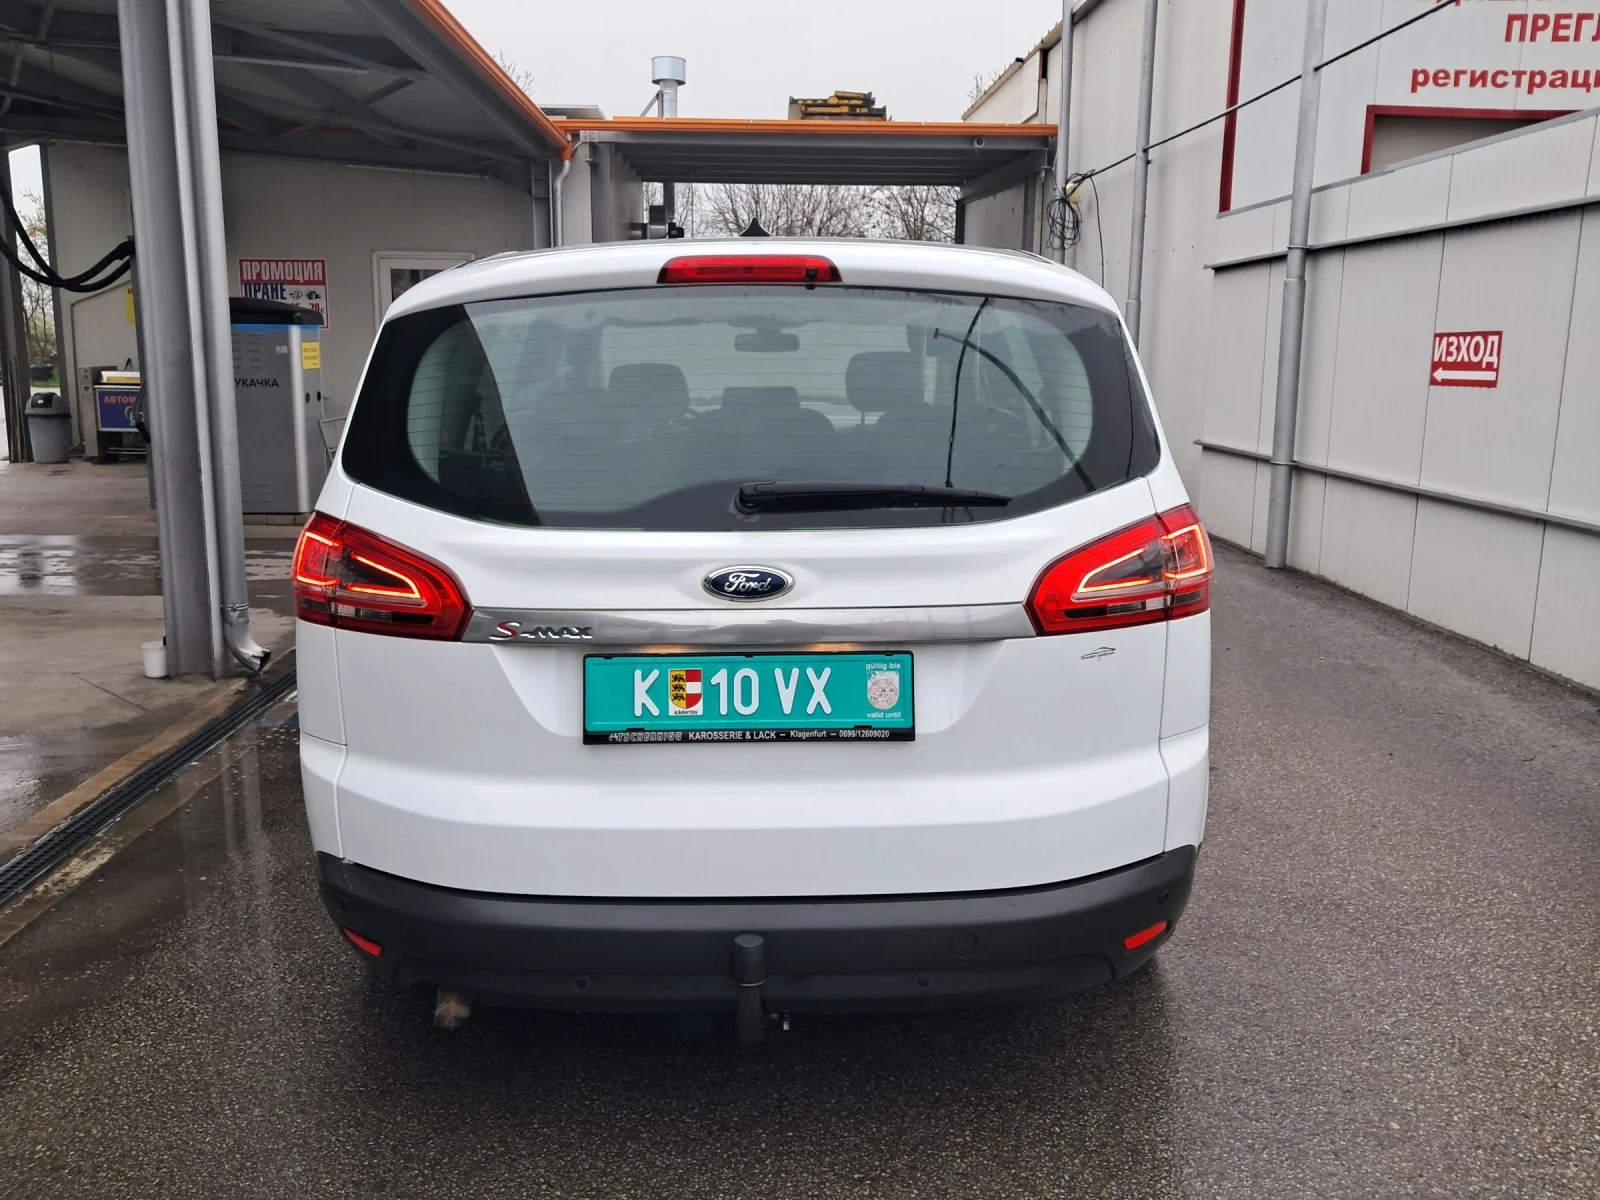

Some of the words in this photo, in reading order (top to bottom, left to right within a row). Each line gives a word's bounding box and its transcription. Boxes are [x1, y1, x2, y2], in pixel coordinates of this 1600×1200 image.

[242, 261, 323, 283] ПРОМОЦИЯ
[244, 282, 288, 300] ПРАНЕ
[1433, 335, 1499, 369] ИЗХОД
[724, 572, 772, 593] Ford
[865, 662, 887, 671] gültig
[633, 669, 660, 717] K
[709, 667, 759, 716] 10
[773, 667, 832, 715] VX
[866, 711, 884, 719] valid
[688, 731, 743, 740] KAROSSERIE
[745, 731, 751, 739] &
[753, 730, 777, 740] LACK
[790, 730, 827, 740] Klagenfurt
